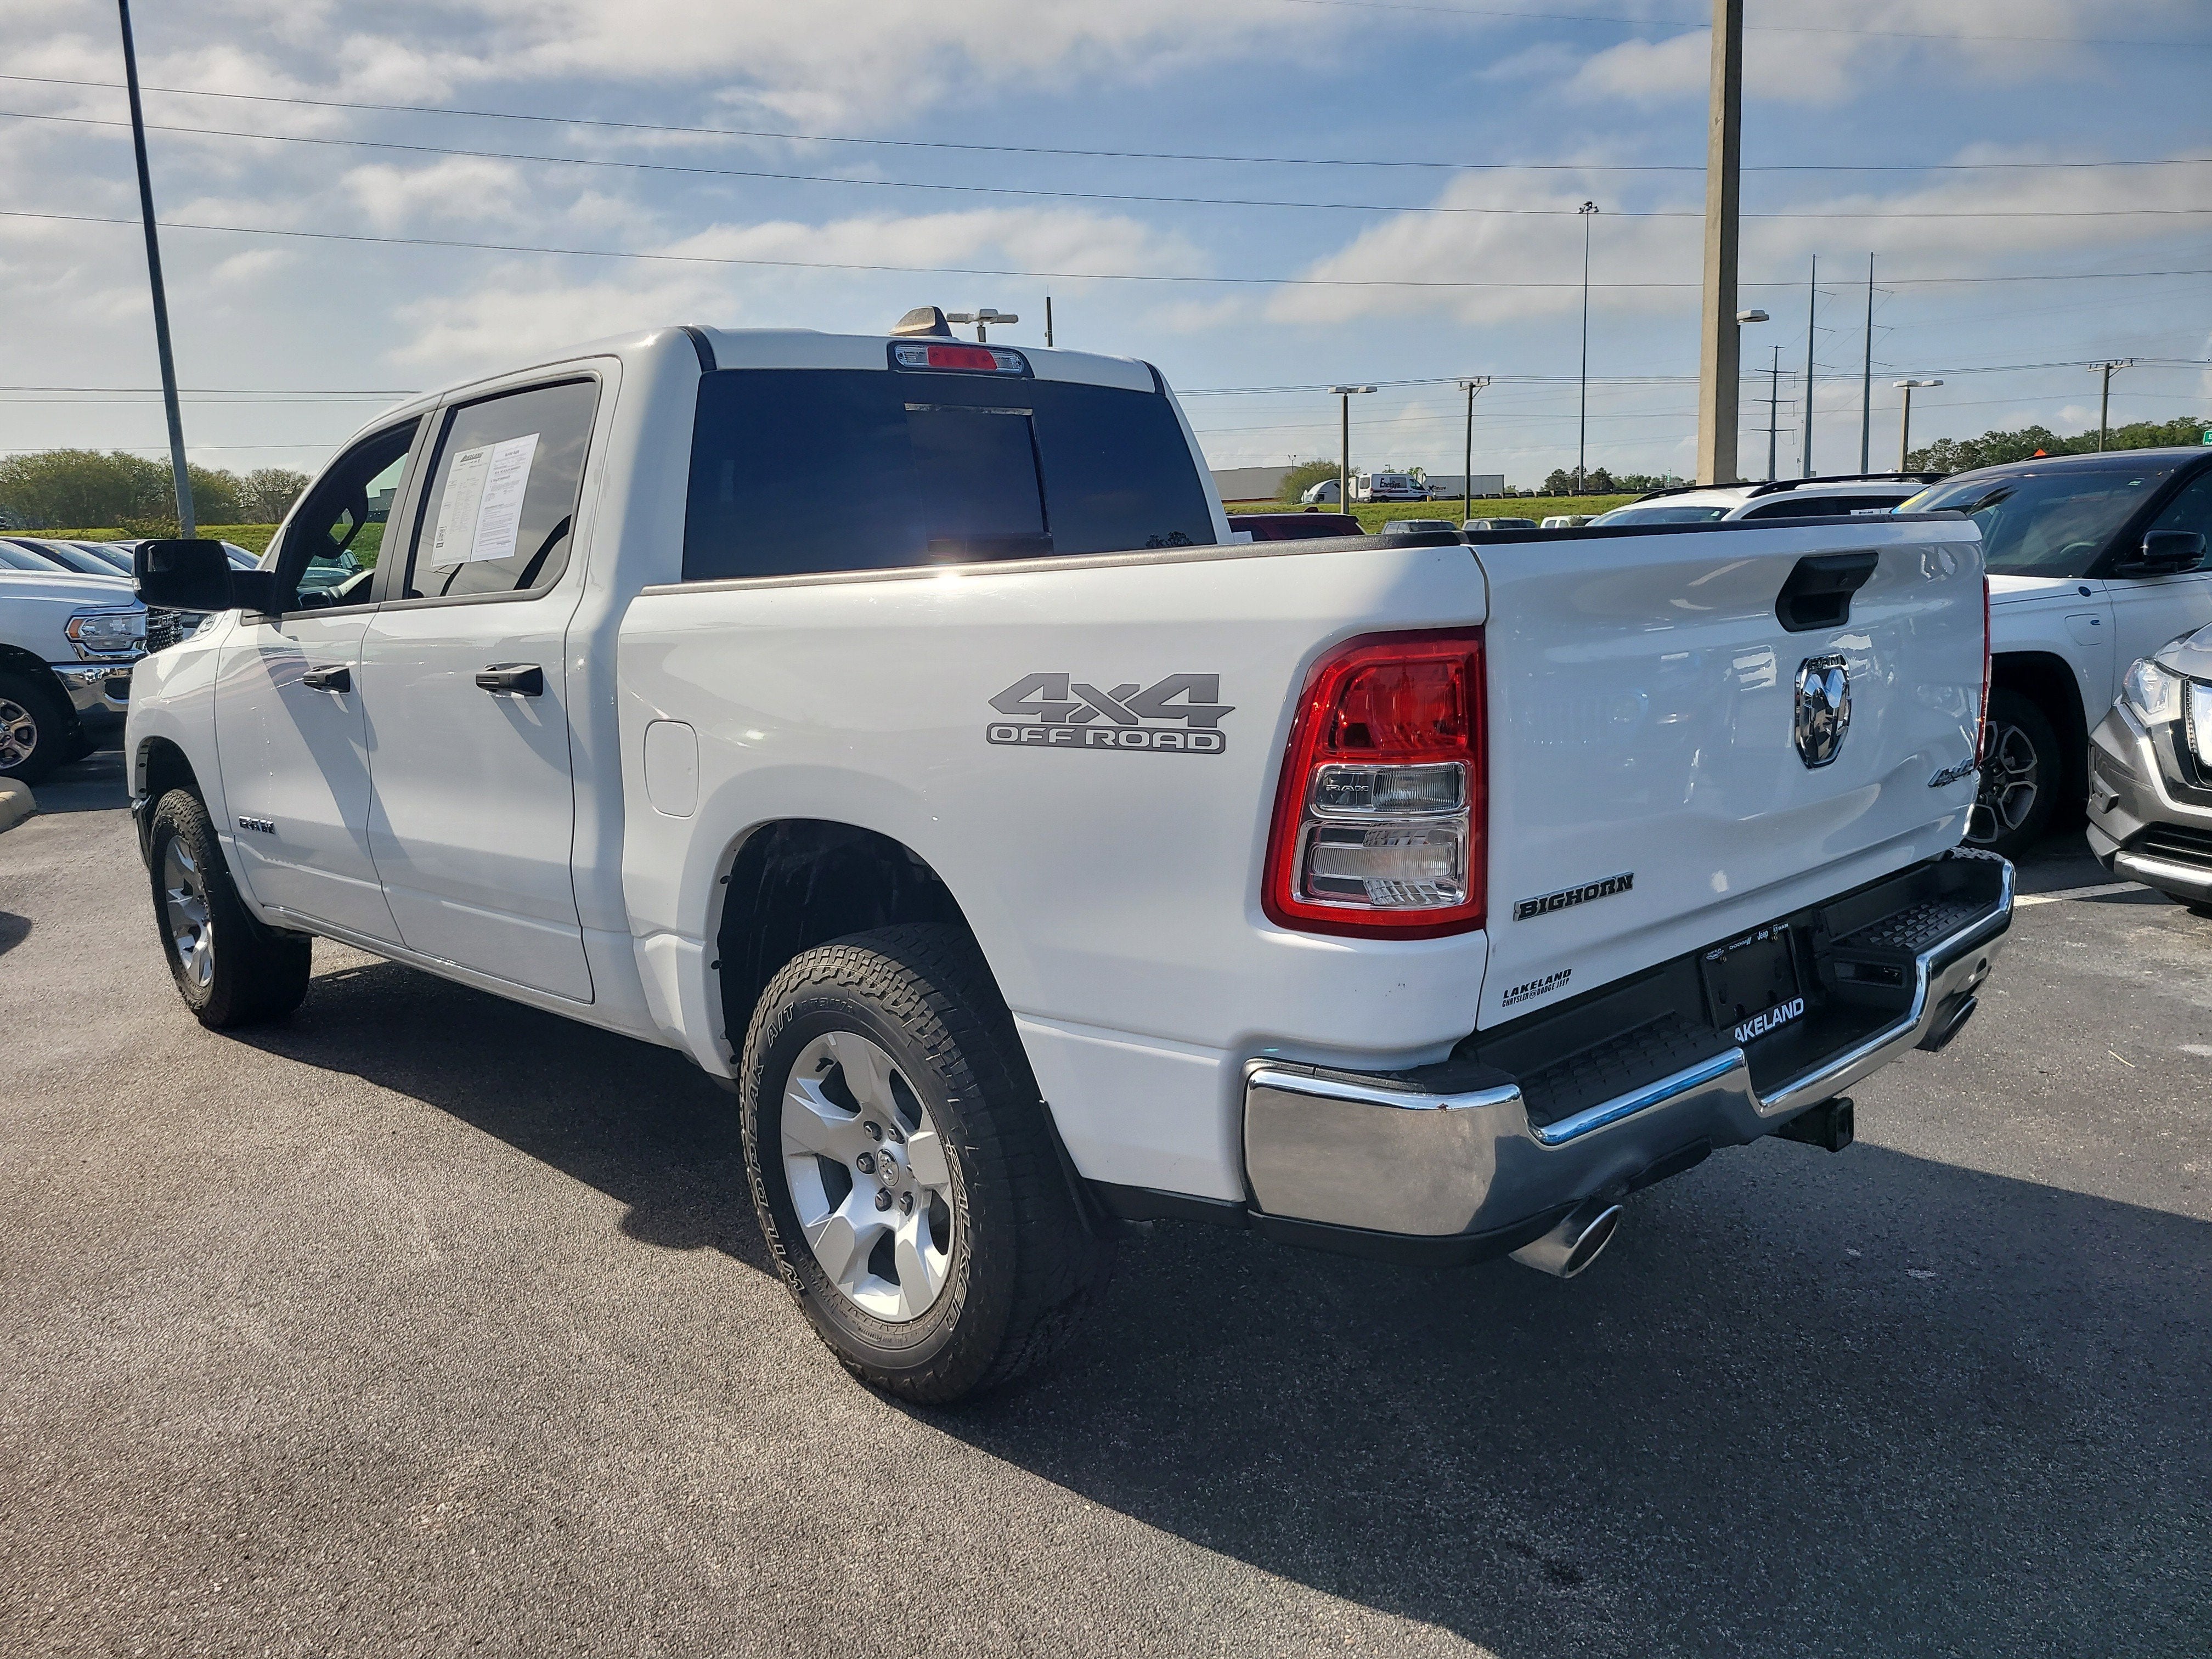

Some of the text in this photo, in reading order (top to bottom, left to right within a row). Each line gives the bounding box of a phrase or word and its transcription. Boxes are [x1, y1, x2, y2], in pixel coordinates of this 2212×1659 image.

[988, 673, 1235, 728] 4x4
[990, 726, 1221, 751] OFF ROAD
[238, 815, 276, 834] RAM
[1513, 870, 1635, 922] BIGHORN
[1729, 939, 1748, 950] DODGE
[1757, 930, 1769, 941] Jeep
[1778, 923, 1789, 931] RAM
[1502, 977, 1570, 1008] CHRYSLER DODGE JEEP
[1503, 968, 1572, 999] LAKELAND
[1734, 998, 1804, 1042] AKELAND
[747, 1052, 805, 1291] WILDPEAK
